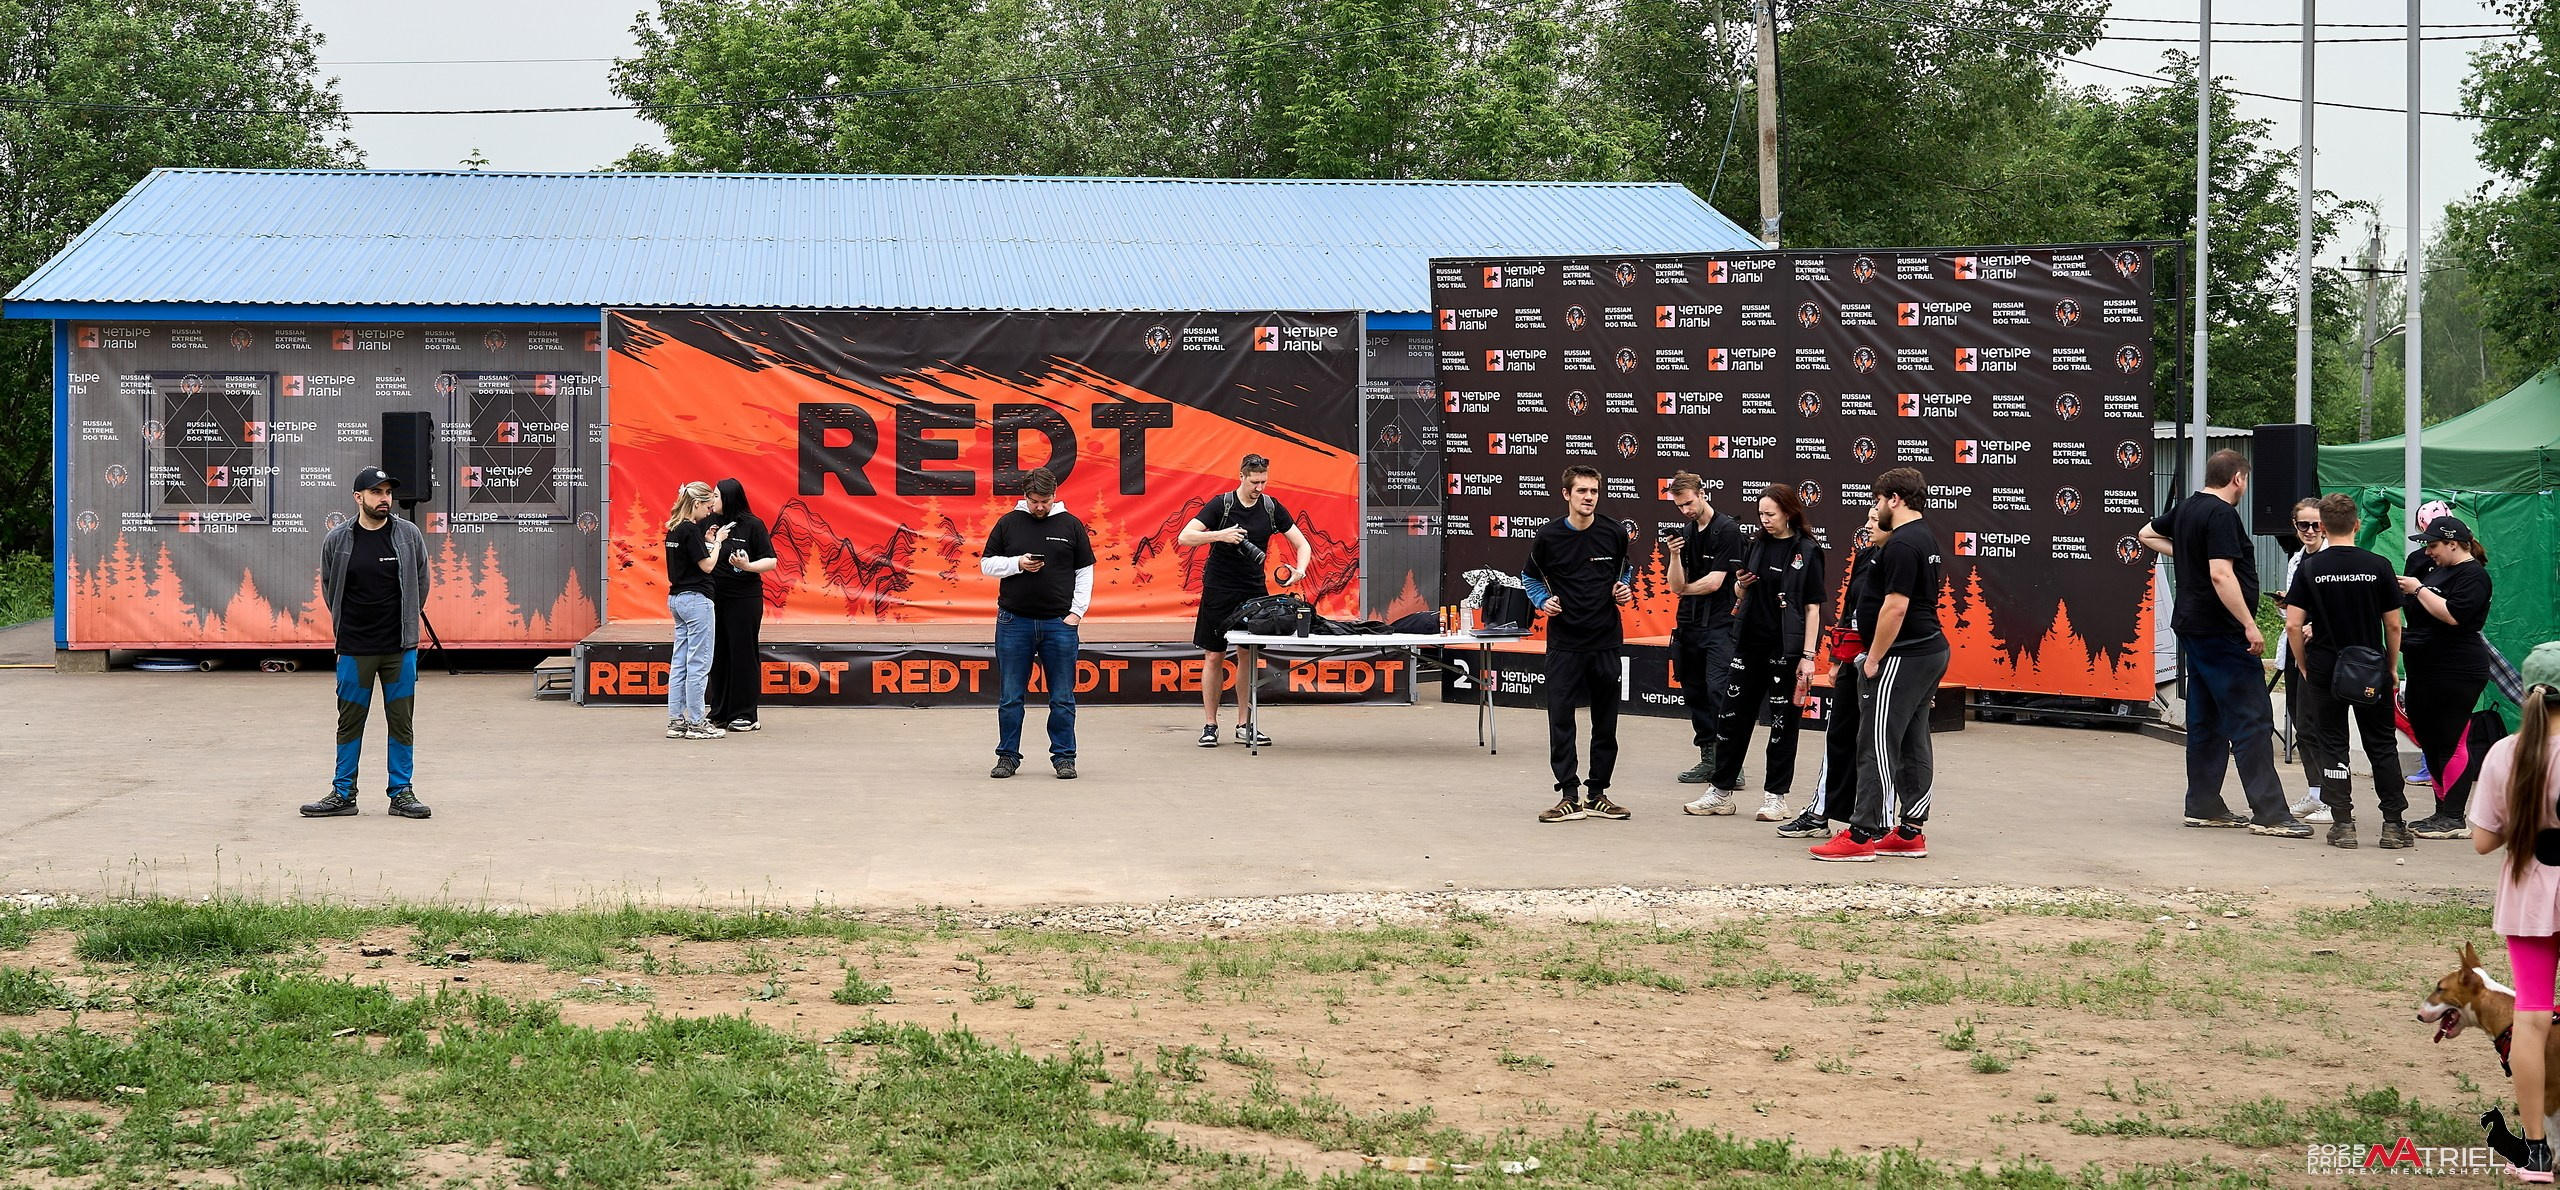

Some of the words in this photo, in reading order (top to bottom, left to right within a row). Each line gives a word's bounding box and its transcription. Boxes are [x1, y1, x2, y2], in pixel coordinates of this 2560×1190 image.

[798, 402, 1173, 496] REDT
[2314, 574, 2377, 584] ОРГАНИЗАТОР
[589, 661, 671, 696] RED
[760, 660, 850, 695] EDT
[871, 660, 990, 694] REDT
[1290, 660, 1404, 693] REDT
[1453, 658, 1472, 689] 2
[2324, 768, 2348, 780] PUMA
